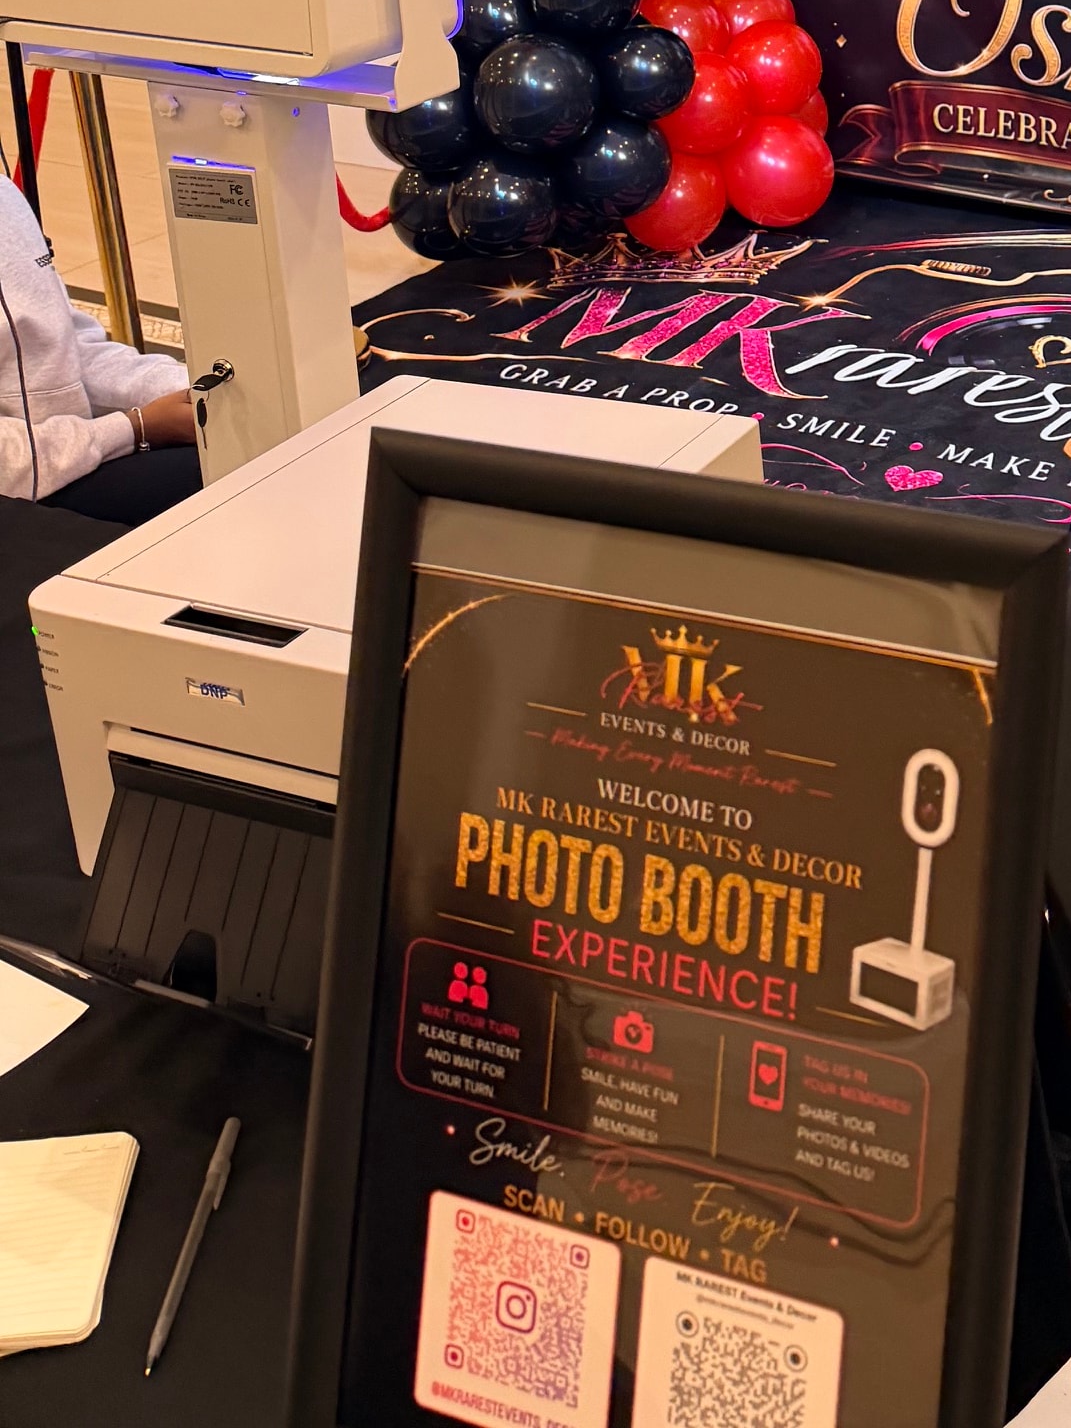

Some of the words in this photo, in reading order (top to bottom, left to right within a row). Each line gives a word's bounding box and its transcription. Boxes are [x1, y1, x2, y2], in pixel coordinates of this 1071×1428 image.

[491, 286, 873, 400] MK
[500, 363, 598, 394] GRAB
[602, 383, 626, 400] A
[640, 387, 740, 416] PROP
[776, 412, 898, 449] SMILE
[937, 443, 1056, 482] MAKE
[600, 711, 667, 739] EVENTS
[671, 727, 685, 743] &
[690, 730, 751, 757] DECOR
[597, 777, 715, 823] WELCOME
[719, 804, 753, 831] TO
[496, 786, 535, 816] MK
[541, 796, 639, 839] RAREST
[644, 819, 742, 863] EVENTS
[746, 843, 766, 868] &
[772, 848, 863, 890] DECOR
[455, 811, 625, 924] PHOTO
[638, 852, 826, 975] BOOTH
[531, 917, 799, 1021] EXPERIENCE!
[417, 1022, 458, 1045] PLEASE
[459, 1033, 475, 1050] BE
[476, 1037, 522, 1062] PATIENT
[425, 1046, 452, 1066] AND
[452, 1053, 481, 1073] WAIT
[481, 1060, 506, 1080] FOR
[430, 1070, 463, 1091] YOUR
[619, 1077, 652, 1098] HAVE
[653, 1085, 680, 1106] FUN
[595, 1094, 622, 1114] AND
[623, 1101, 658, 1122] MAKE
[798, 1103, 839, 1126] SHARE
[842, 1115, 876, 1136] YOUR
[795, 1149, 825, 1169] AND
[826, 1157, 851, 1177] TAG
[797, 1125, 849, 1152] PHOTOS
[850, 1139, 860, 1155] &
[861, 1142, 911, 1169] VIDEOS
[504, 1183, 566, 1223] SCAN
[595, 1210, 691, 1262] FOLLOW
[720, 1247, 768, 1285] TAG
[693, 1181, 799, 1253] Enjoy!
